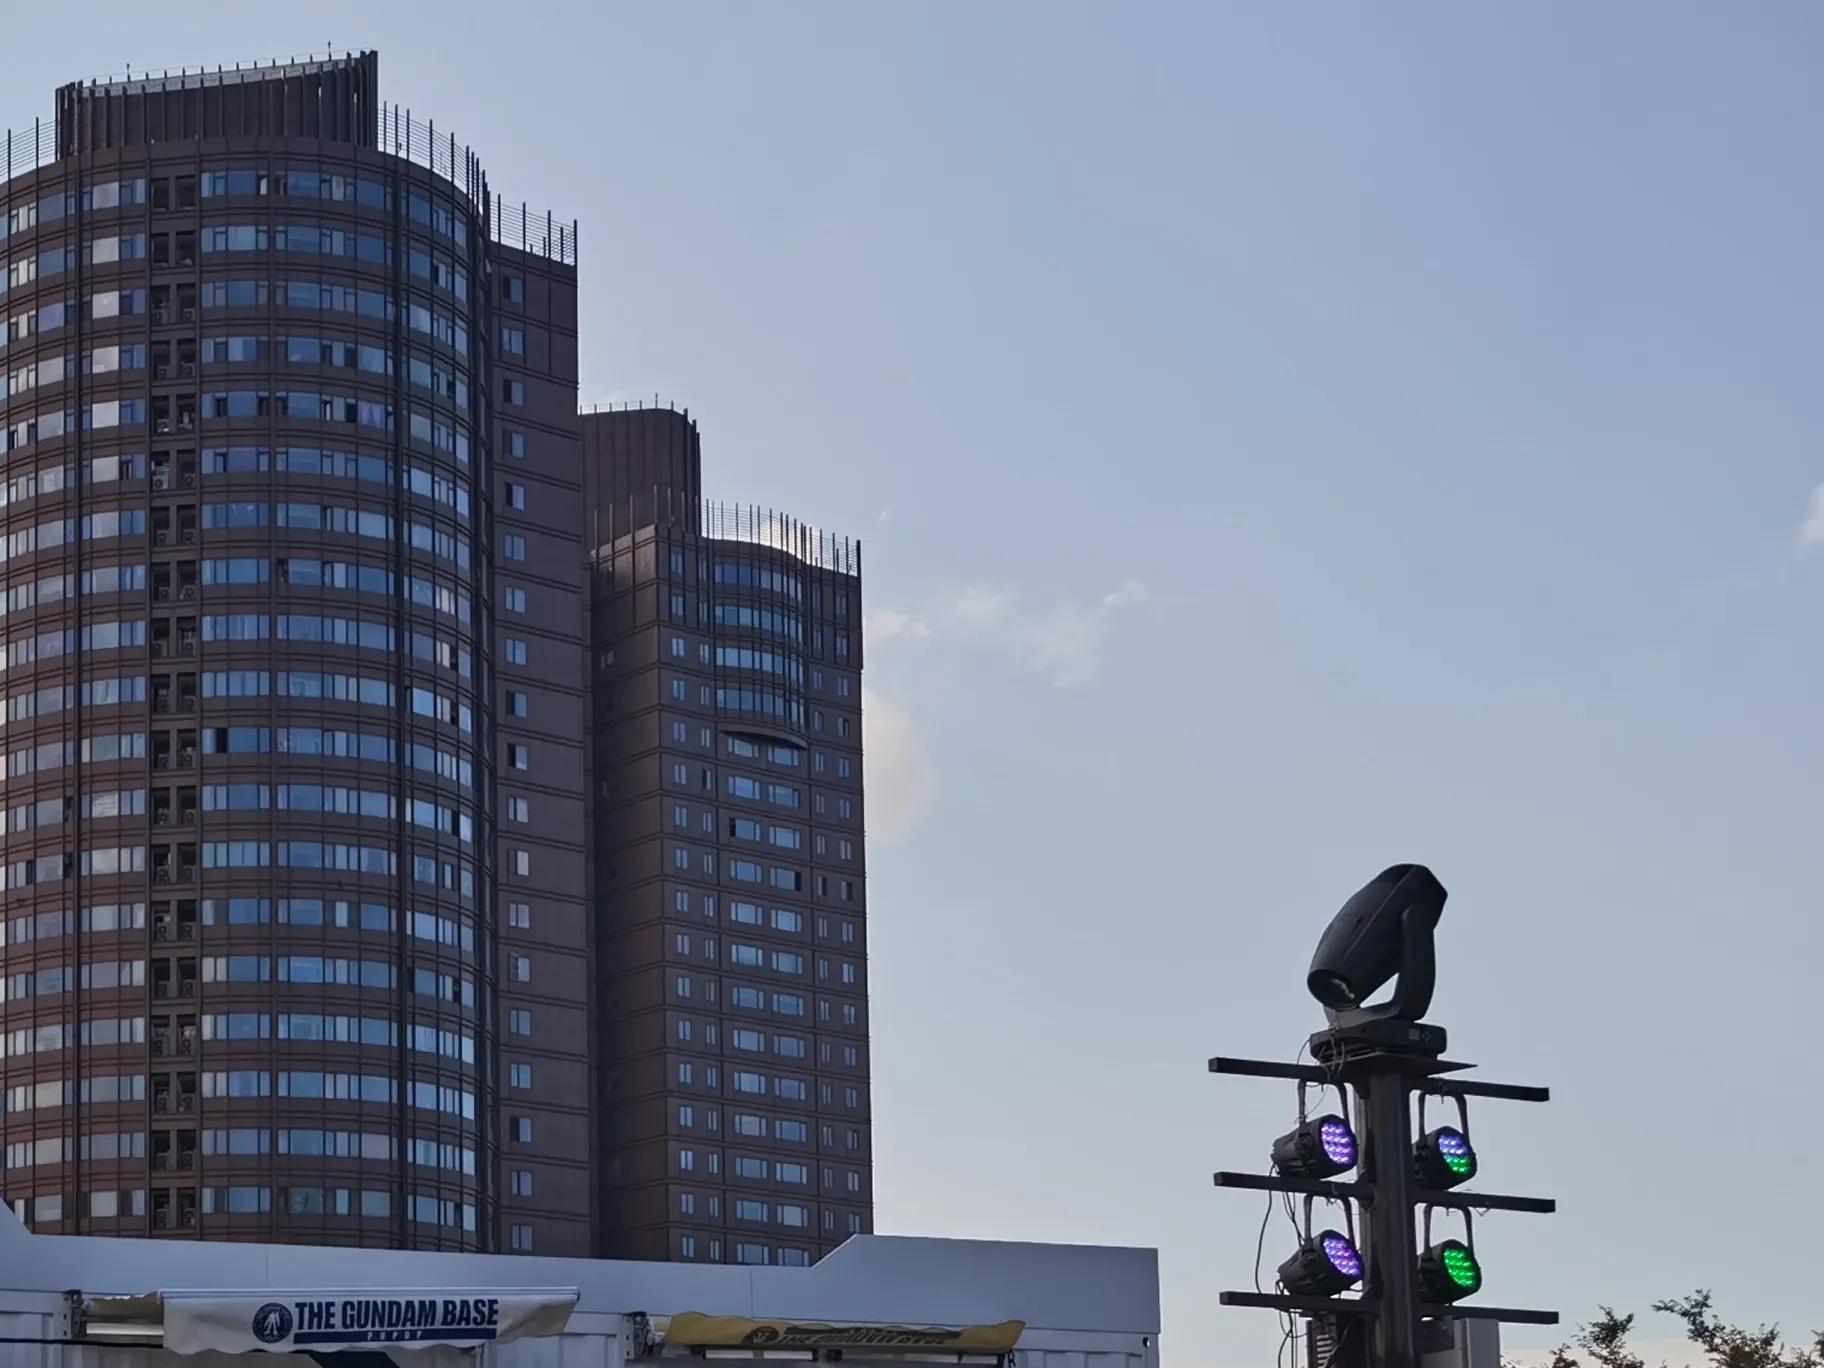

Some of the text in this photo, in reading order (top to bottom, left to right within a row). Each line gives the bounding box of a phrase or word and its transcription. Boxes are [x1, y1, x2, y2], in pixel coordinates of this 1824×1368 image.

[295, 1299, 499, 1330] THE GUNDAM BASE
